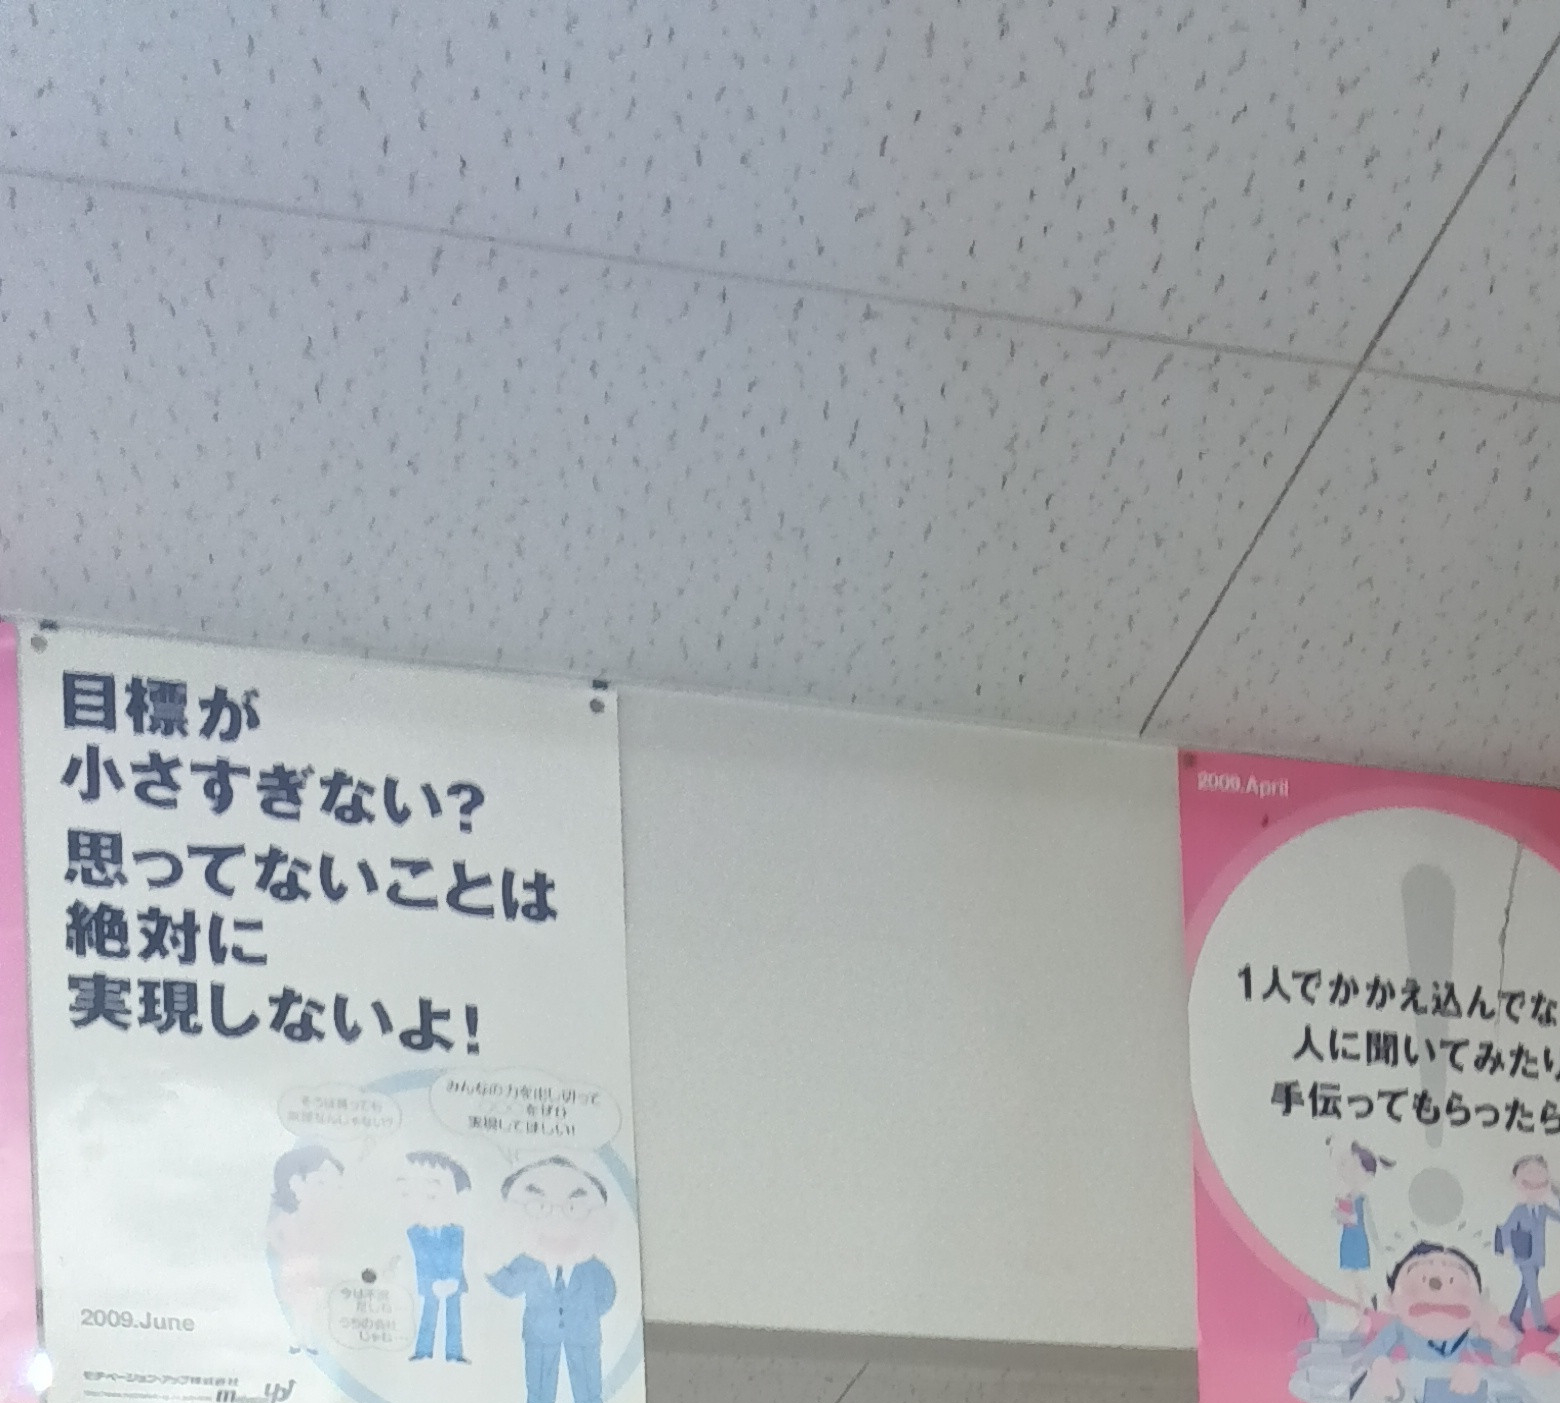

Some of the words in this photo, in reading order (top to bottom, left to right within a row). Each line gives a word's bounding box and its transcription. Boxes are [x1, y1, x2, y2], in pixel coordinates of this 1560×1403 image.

[62, 669, 261, 742] 目標が
[61, 743, 487, 832] 小さすぎない?
[65, 828, 559, 922] 思ってないことは
[65, 902, 270, 968] 絶対に
[68, 974, 482, 1056] 実現しないよ!
[81, 1308, 196, 1332] 2009.June
